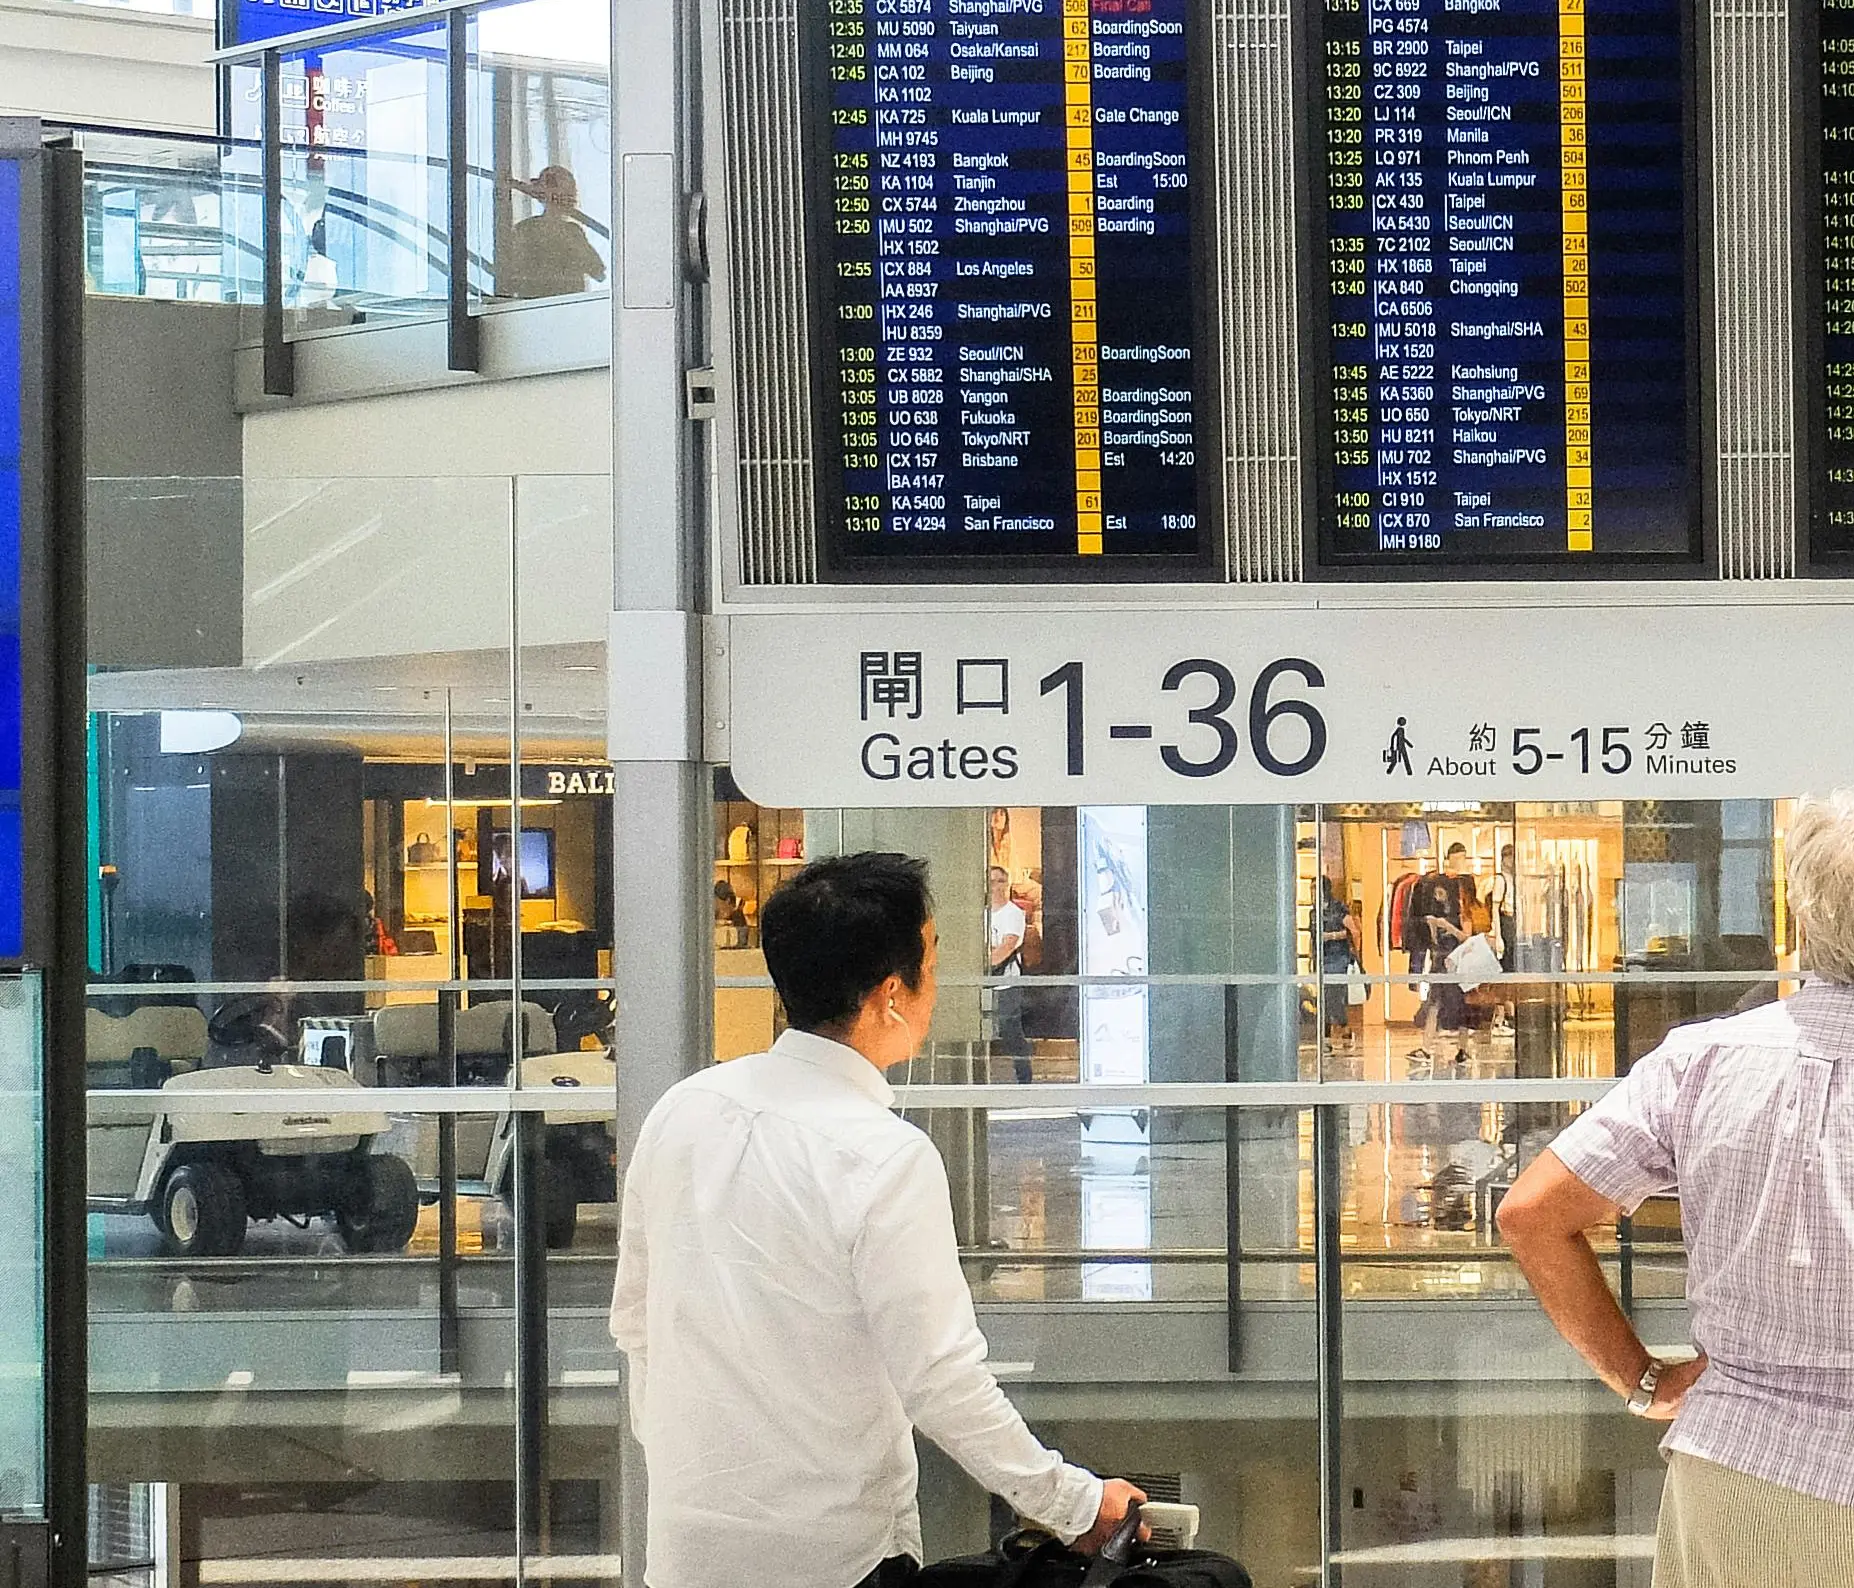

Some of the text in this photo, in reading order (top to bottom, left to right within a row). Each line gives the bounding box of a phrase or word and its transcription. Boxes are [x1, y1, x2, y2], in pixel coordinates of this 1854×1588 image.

[830, 20, 1182, 38] 12:35 MU 5090 Taiyuan 62 BoardingSoon
[830, 42, 1150, 59] 12:40 MM 064 Osaka/Kansai 217 Boarding
[1326, 40, 1582, 58] 13:15 BR 2900 Taipei 216
[832, 108, 1179, 126] 12:45 KA 725 Kuala Lumpur 42 Gate Change
[1328, 128, 1584, 143] 13:20 PR 319 Manila 36
[1328, 150, 1583, 165] 13:25 LQ 971 Phnom Penh 504
[834, 174, 1187, 192] 12:50 KA 1104 Tianjin Est 15:00
[1334, 407, 1588, 424] 13:45 UO 650 Tokyo/NRT 215
[846, 515, 1195, 531] 13:10 EY 4294 San Francisco Est 18:00
[861, 652, 1010, 722] 閘口
[1038, 658, 1328, 779] 1-36
[1469, 724, 1497, 753] 約
[1643, 721, 1711, 752] 分鐘
[862, 733, 1020, 782] Gates
[1513, 728, 1633, 777] 5-15
[1427, 758, 1497, 777] About
[1647, 754, 1738, 775] Minutes
